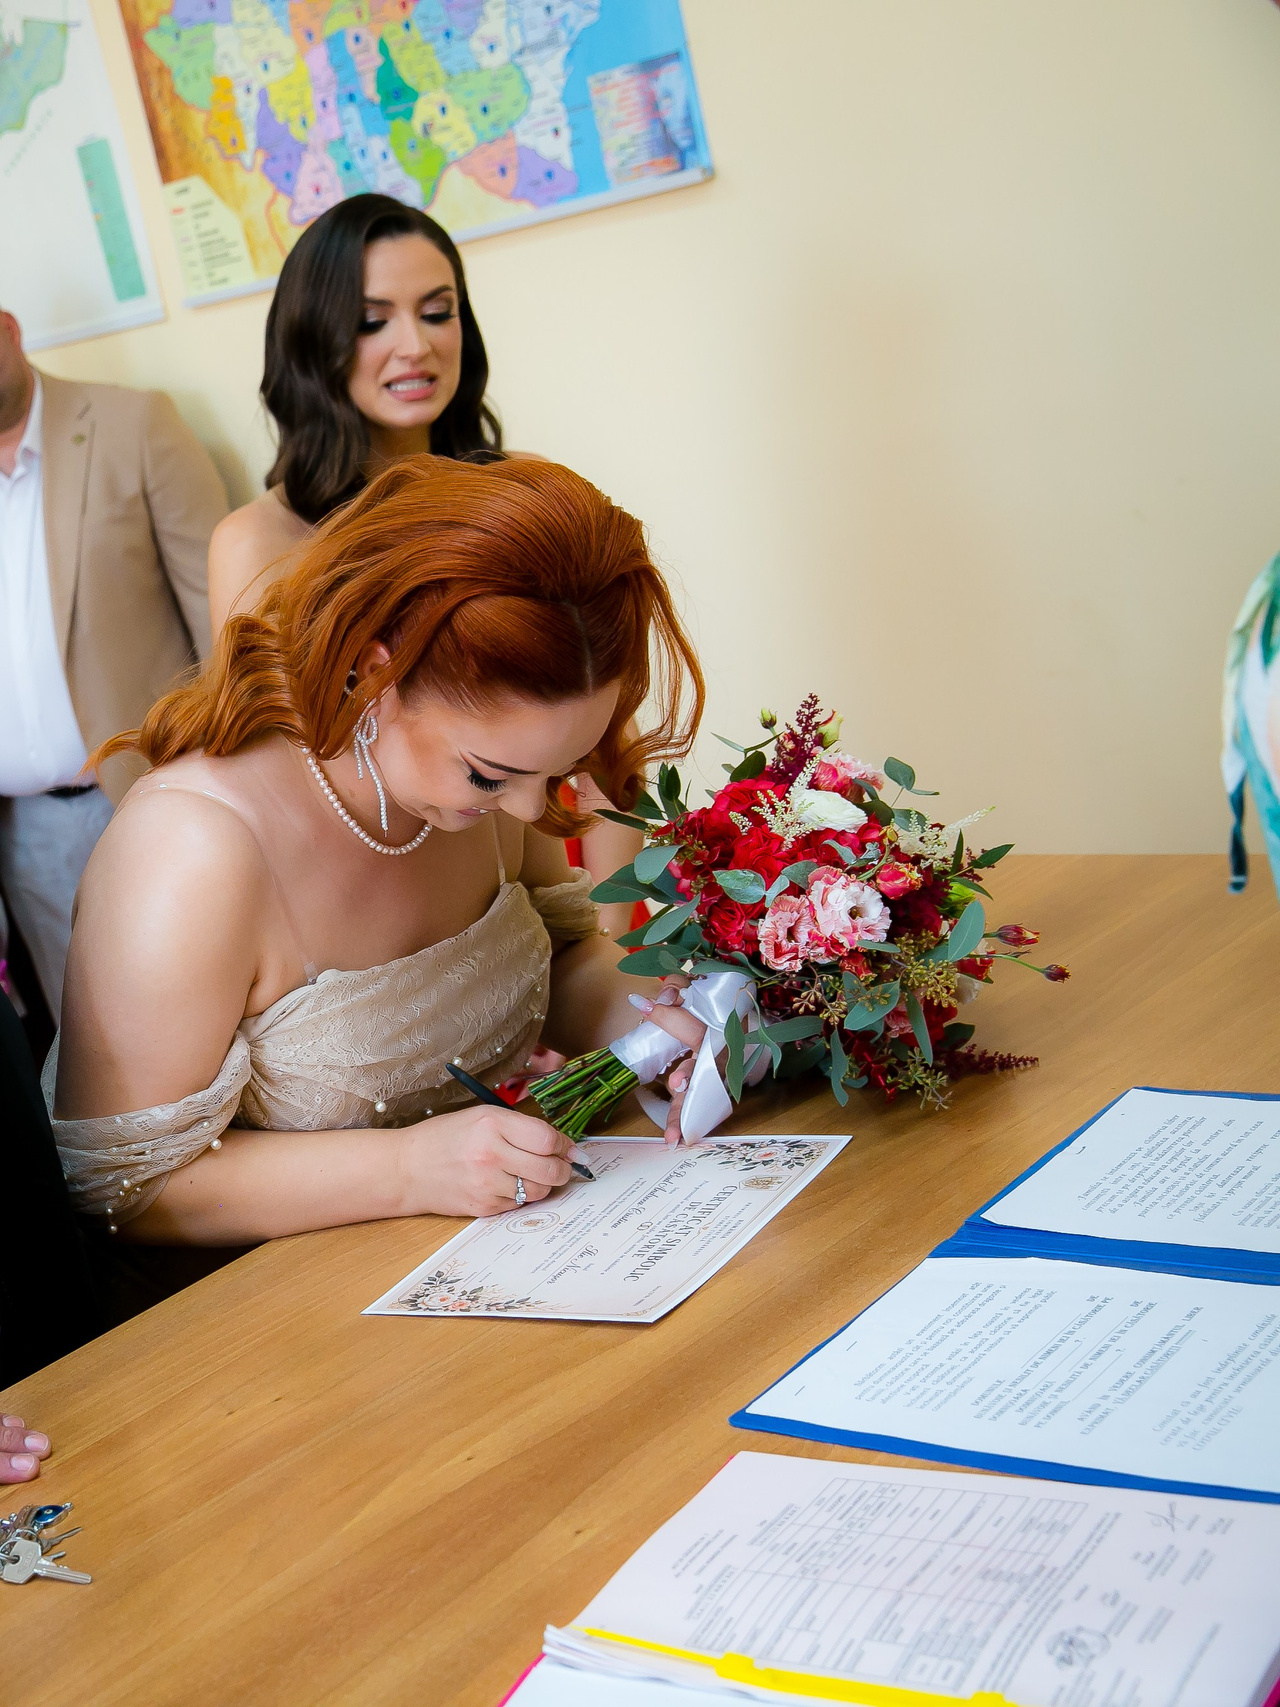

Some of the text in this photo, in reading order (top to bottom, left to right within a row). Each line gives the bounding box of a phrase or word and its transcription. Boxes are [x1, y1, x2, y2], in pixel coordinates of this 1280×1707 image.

[631, 1201, 703, 1258] DE CĂSĂTORIE
[674, 1185, 741, 1237] CERTIFICAT
[623, 1238, 682, 1282] SIMBOLIC
